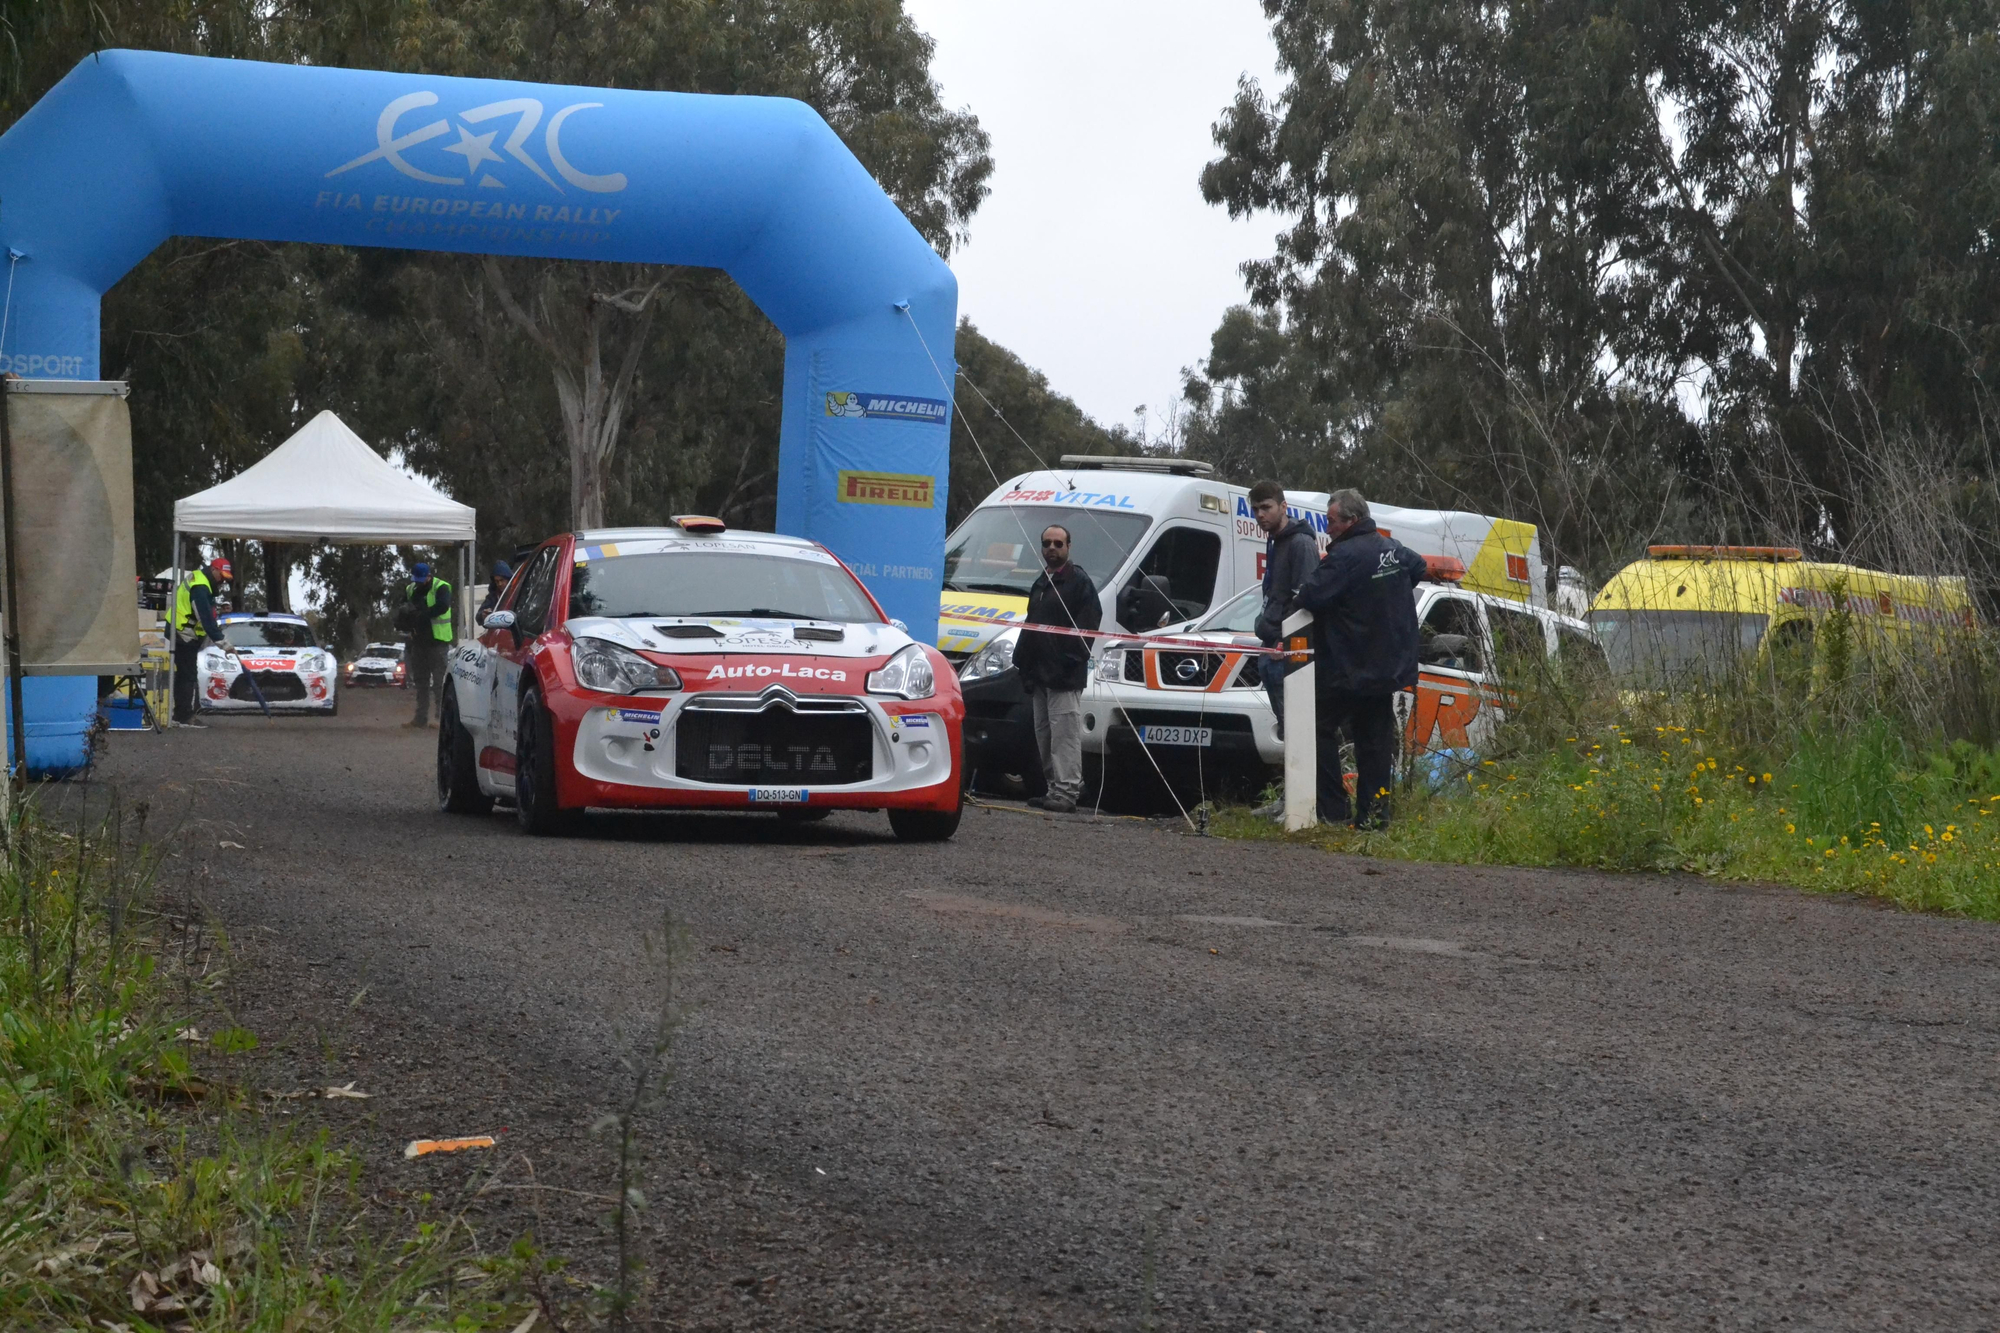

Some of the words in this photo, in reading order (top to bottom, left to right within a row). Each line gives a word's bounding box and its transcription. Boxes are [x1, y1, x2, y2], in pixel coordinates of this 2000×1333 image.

[324, 91, 628, 195] ERC
[315, 191, 362, 210] FIA
[372, 195, 527, 221] EUROPEAN
[534, 204, 622, 226] RALLY
[867, 399, 946, 417] MICHELIN
[846, 476, 929, 502] PIRELLI
[695, 542, 756, 550] LOPESAN
[883, 564, 933, 580] PARTNERS
[713, 637, 814, 648] LOPESAN
[706, 663, 847, 682] Auto-Laca
[624, 712, 660, 720] MICHELIN
[1147, 728, 1180, 742] 4023
[1183, 729, 1208, 743] DXP
[709, 743, 837, 771] DELTA
[756, 790, 801, 800] DQ-513-GN
